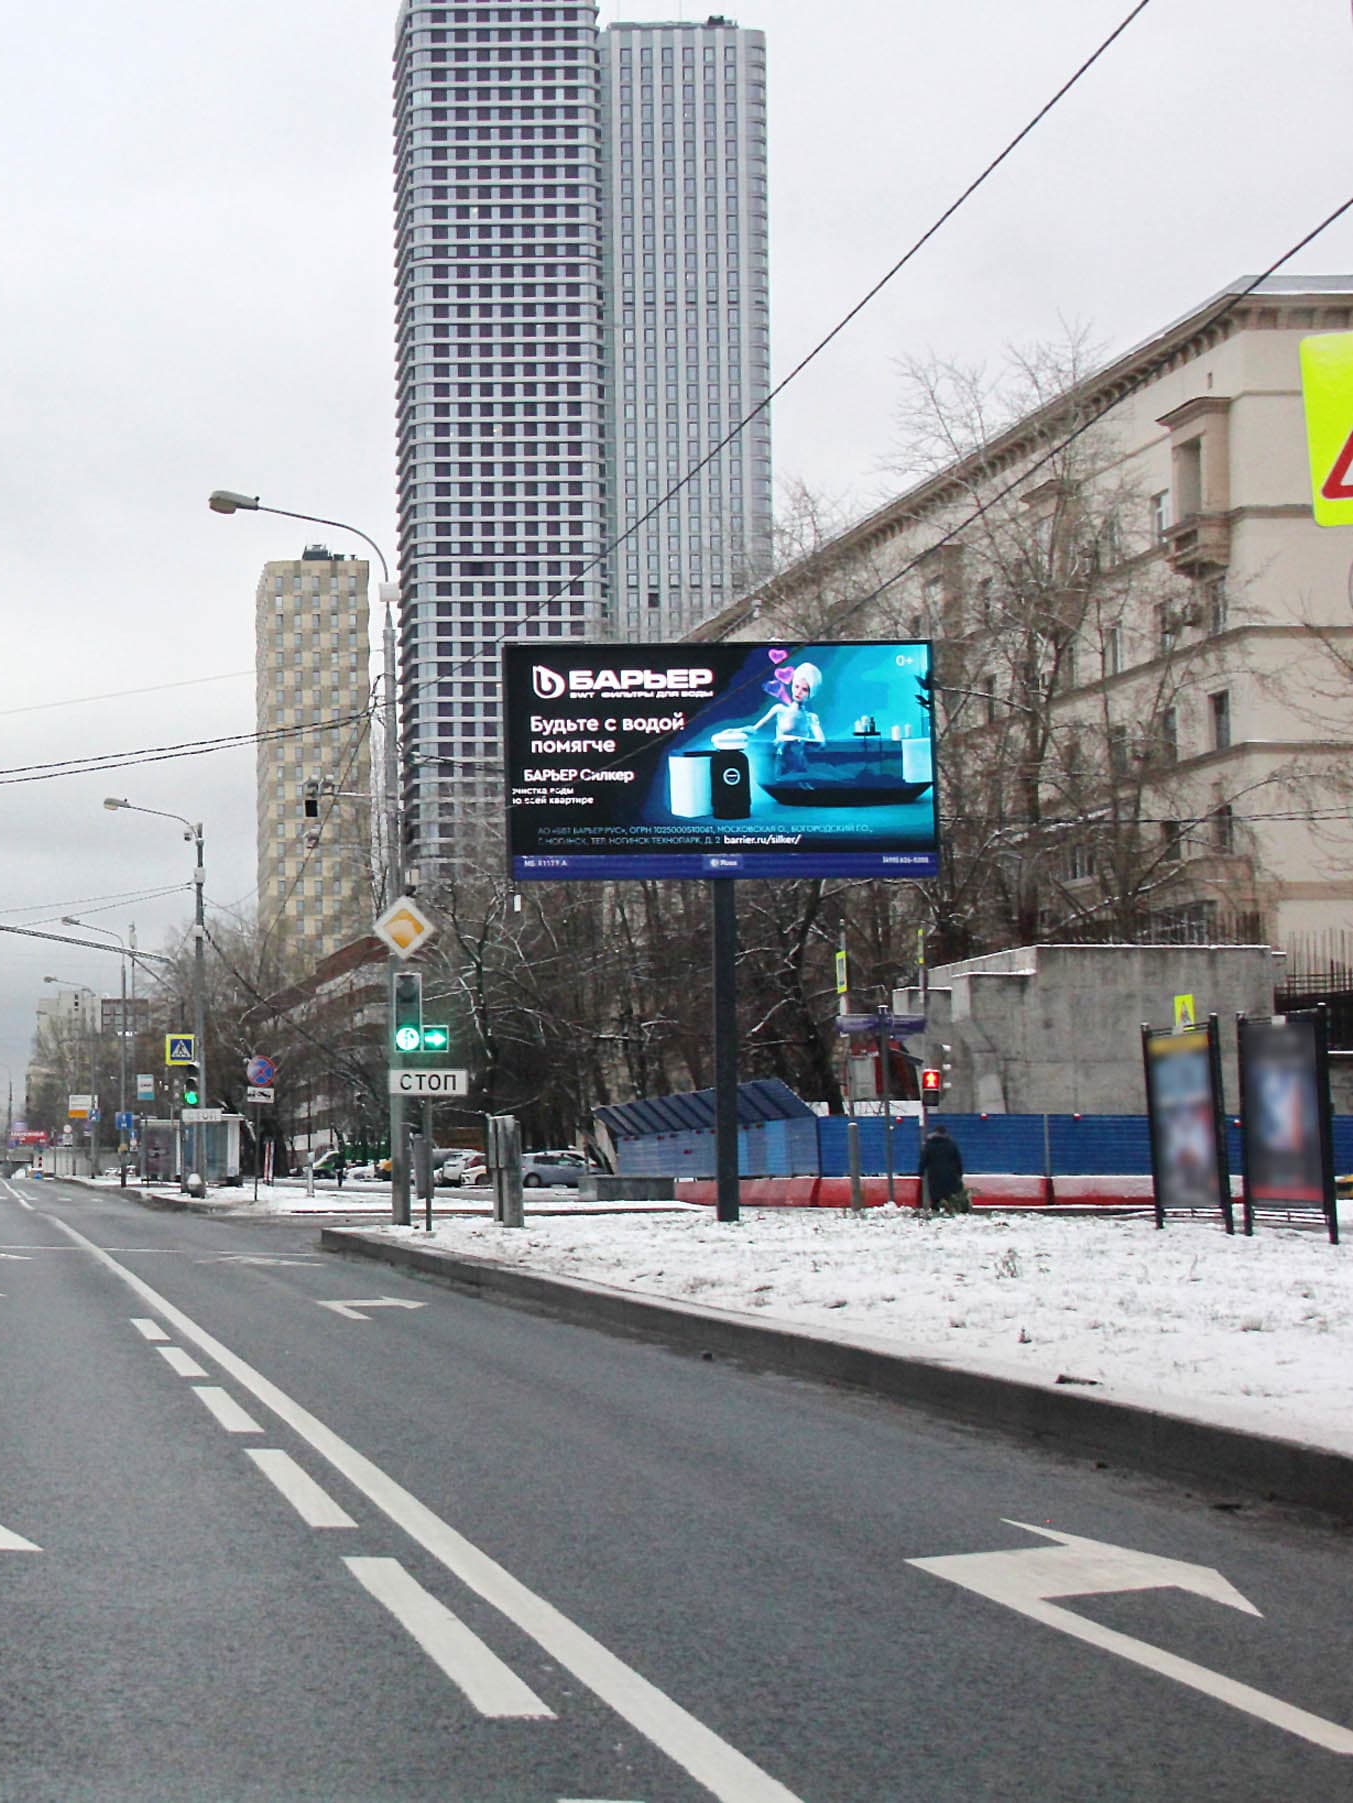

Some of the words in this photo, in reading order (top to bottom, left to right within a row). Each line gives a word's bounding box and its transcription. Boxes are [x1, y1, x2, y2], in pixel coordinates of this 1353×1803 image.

[895, 655, 913, 667] 0+
[568, 668, 714, 690] БАРЬЕР
[530, 715, 599, 736] Будьте
[604, 718, 617, 731] с
[622, 712, 685, 733] водой
[531, 739, 616, 754] помягче
[523, 768, 578, 782] БАРЬЕР
[580, 768, 635, 783] Силкер
[549, 797, 594, 805] квартире
[723, 834, 802, 845] barrier.ru/silker/
[400, 1073, 457, 1091] СТОП
